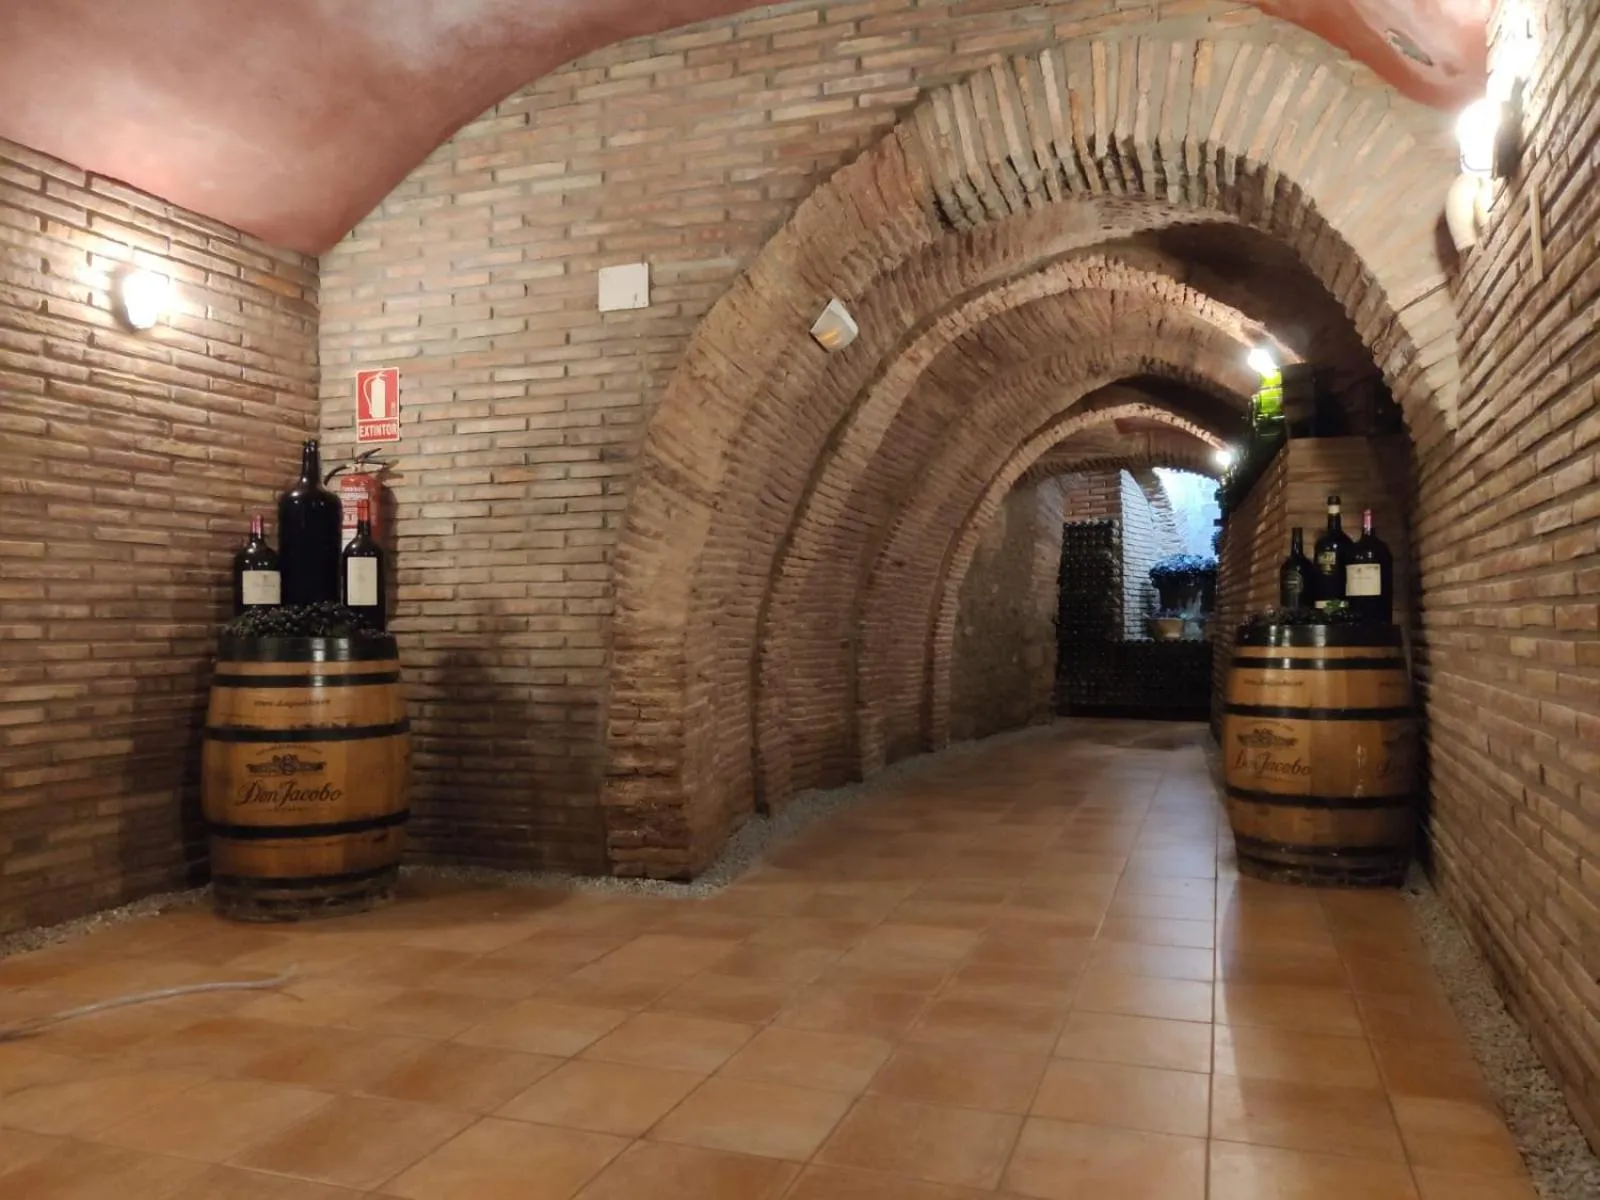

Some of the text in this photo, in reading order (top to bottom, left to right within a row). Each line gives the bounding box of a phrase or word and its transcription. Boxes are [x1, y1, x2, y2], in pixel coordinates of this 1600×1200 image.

[359, 424, 398, 438] EXTINTOR
[1234, 749, 1312, 775] Dn Jacobo
[234, 778, 343, 806] Don Jacobo
